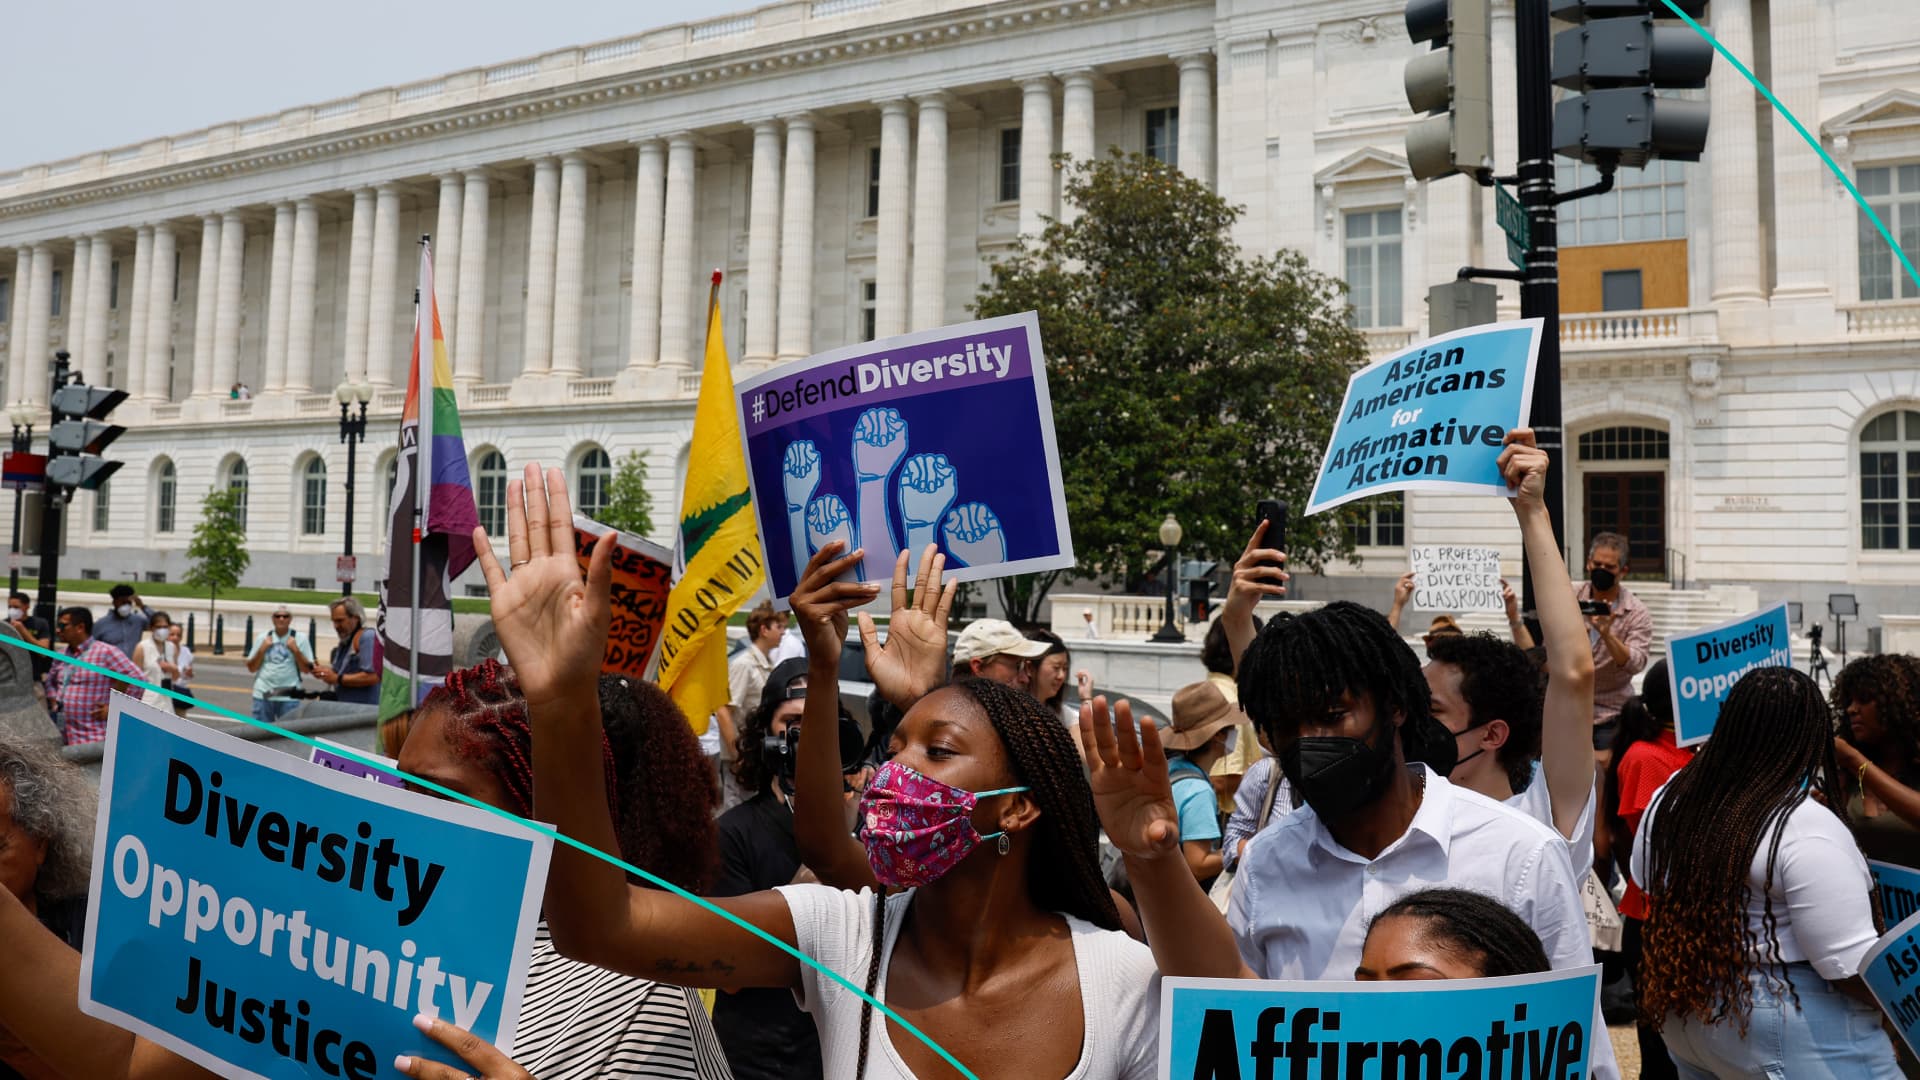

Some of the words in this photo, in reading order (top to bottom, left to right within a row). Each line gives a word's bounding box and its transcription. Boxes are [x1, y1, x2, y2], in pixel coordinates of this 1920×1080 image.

[752, 342, 1012, 424] #DefendDiversity
[1382, 346, 1465, 388] Asian
[1346, 368, 1506, 424] Americans
[1391, 407, 1423, 428] for
[1327, 417, 1504, 474] Affirmative
[1346, 454, 1449, 490] Action
[1428, 562, 1479, 573] SUPPORT
[1438, 547, 1500, 562] PROFESSOR
[1415, 589, 1503, 609] CLASSROOMS
[1427, 574, 1491, 588] DIVERSE
[658, 607, 700, 684] READ
[695, 577, 734, 611] ON
[725, 547, 761, 585] MY
[1695, 623, 1774, 664] Diversity
[163, 758, 445, 926] Diversity
[112, 834, 494, 1033] Opportunity
[175, 956, 378, 1080] Justice
